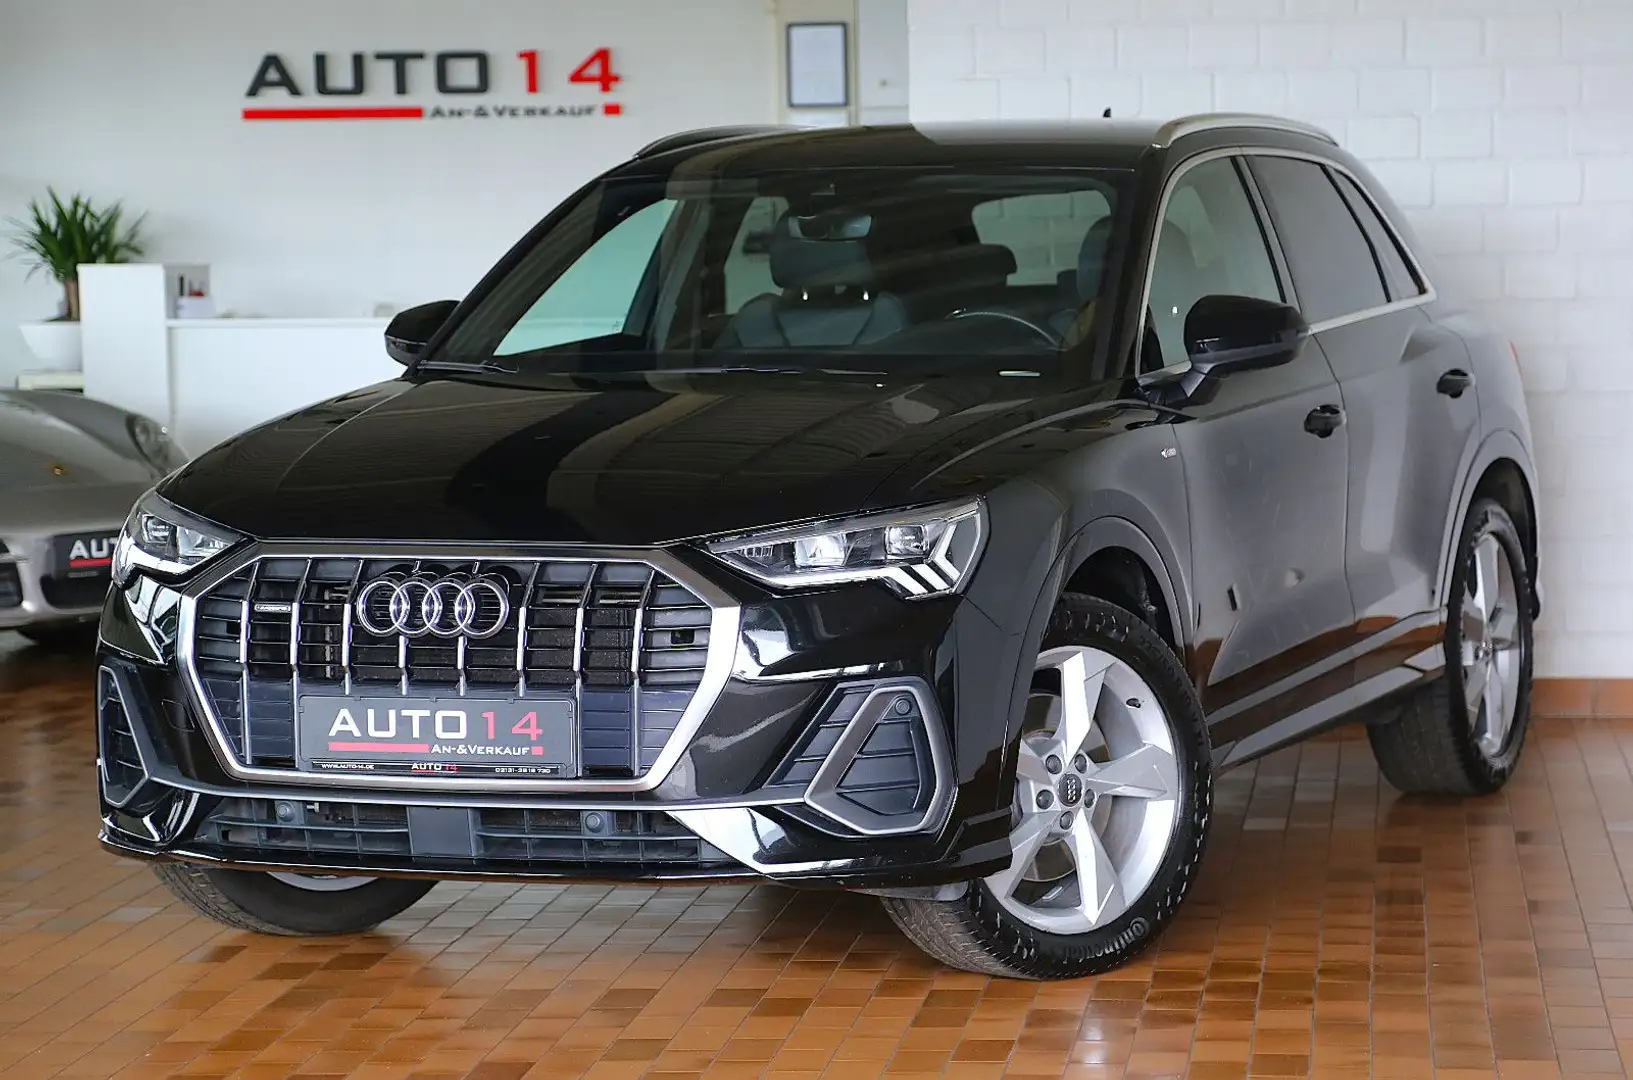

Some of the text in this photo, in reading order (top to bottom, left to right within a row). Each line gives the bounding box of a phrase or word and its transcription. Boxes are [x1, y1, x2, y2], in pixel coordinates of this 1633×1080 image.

[246, 47, 621, 97] AUTO 14
[328, 708, 544, 741] AUTO 14
[411, 762, 442, 771] AUTO
